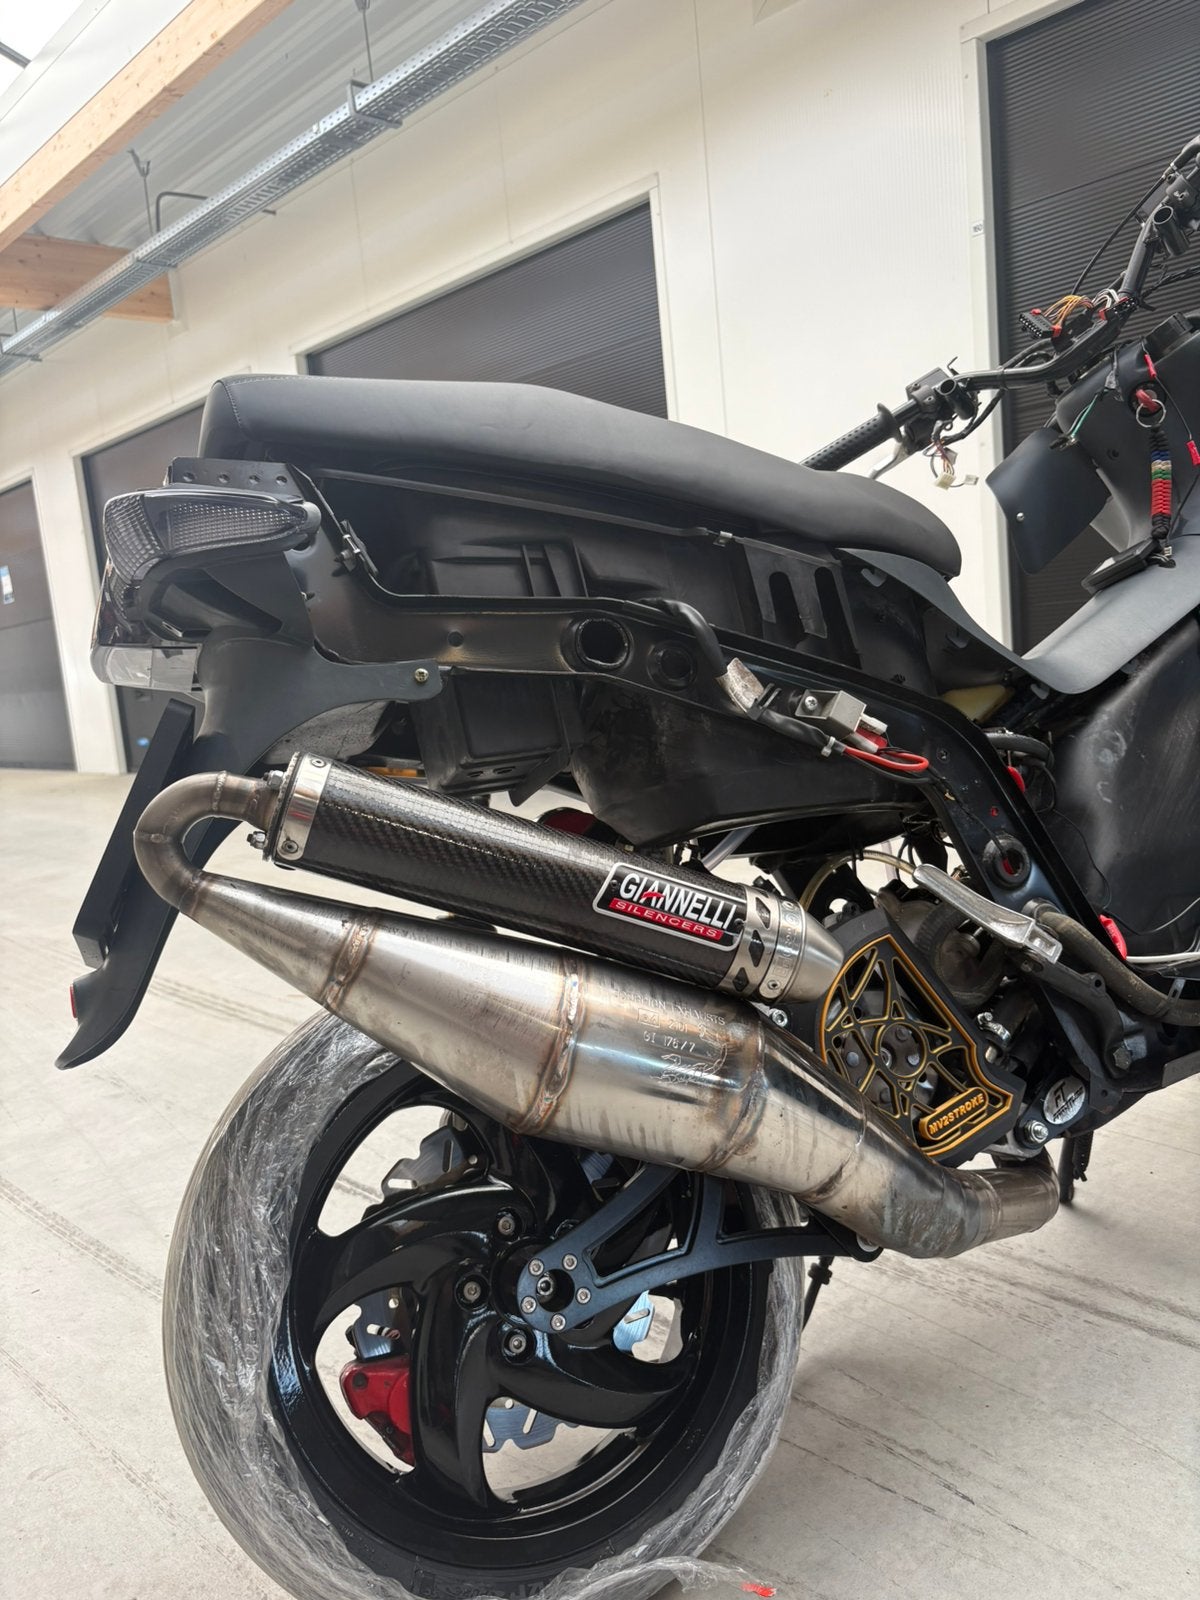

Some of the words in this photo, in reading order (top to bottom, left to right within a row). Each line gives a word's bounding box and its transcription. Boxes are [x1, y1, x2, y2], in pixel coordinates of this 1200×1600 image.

[615, 901, 718, 938] SILENCERS
[619, 873, 737, 929] GIANNELLI
[928, 1093, 985, 1135] MV2STROKE
